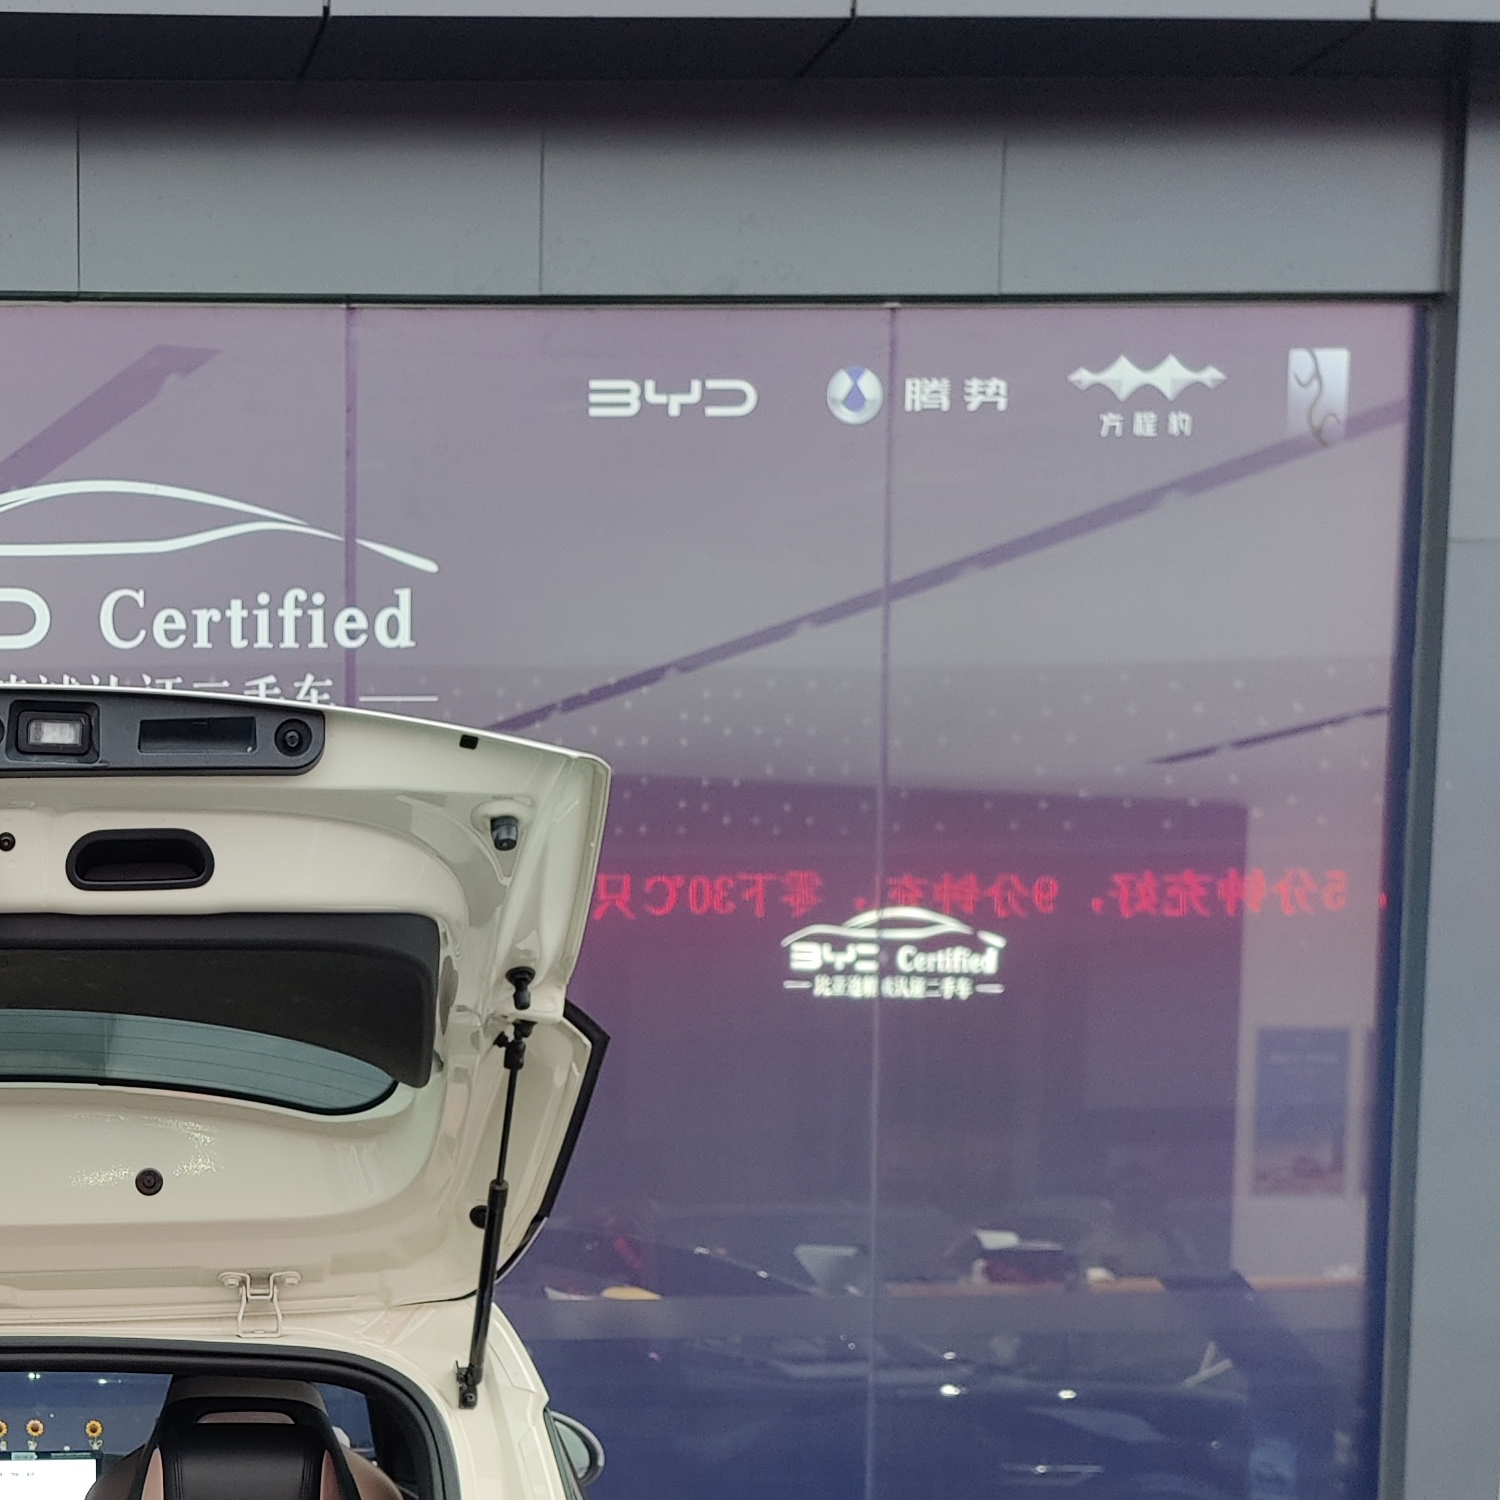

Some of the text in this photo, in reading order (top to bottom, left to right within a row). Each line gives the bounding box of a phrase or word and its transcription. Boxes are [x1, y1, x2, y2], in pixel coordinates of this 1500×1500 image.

[588, 379, 758, 417] BYD
[904, 377, 1008, 412] 腾势
[1099, 411, 1193, 437] 方程豹
[99, 588, 416, 650] Certified
[897, 946, 998, 973] Certified
